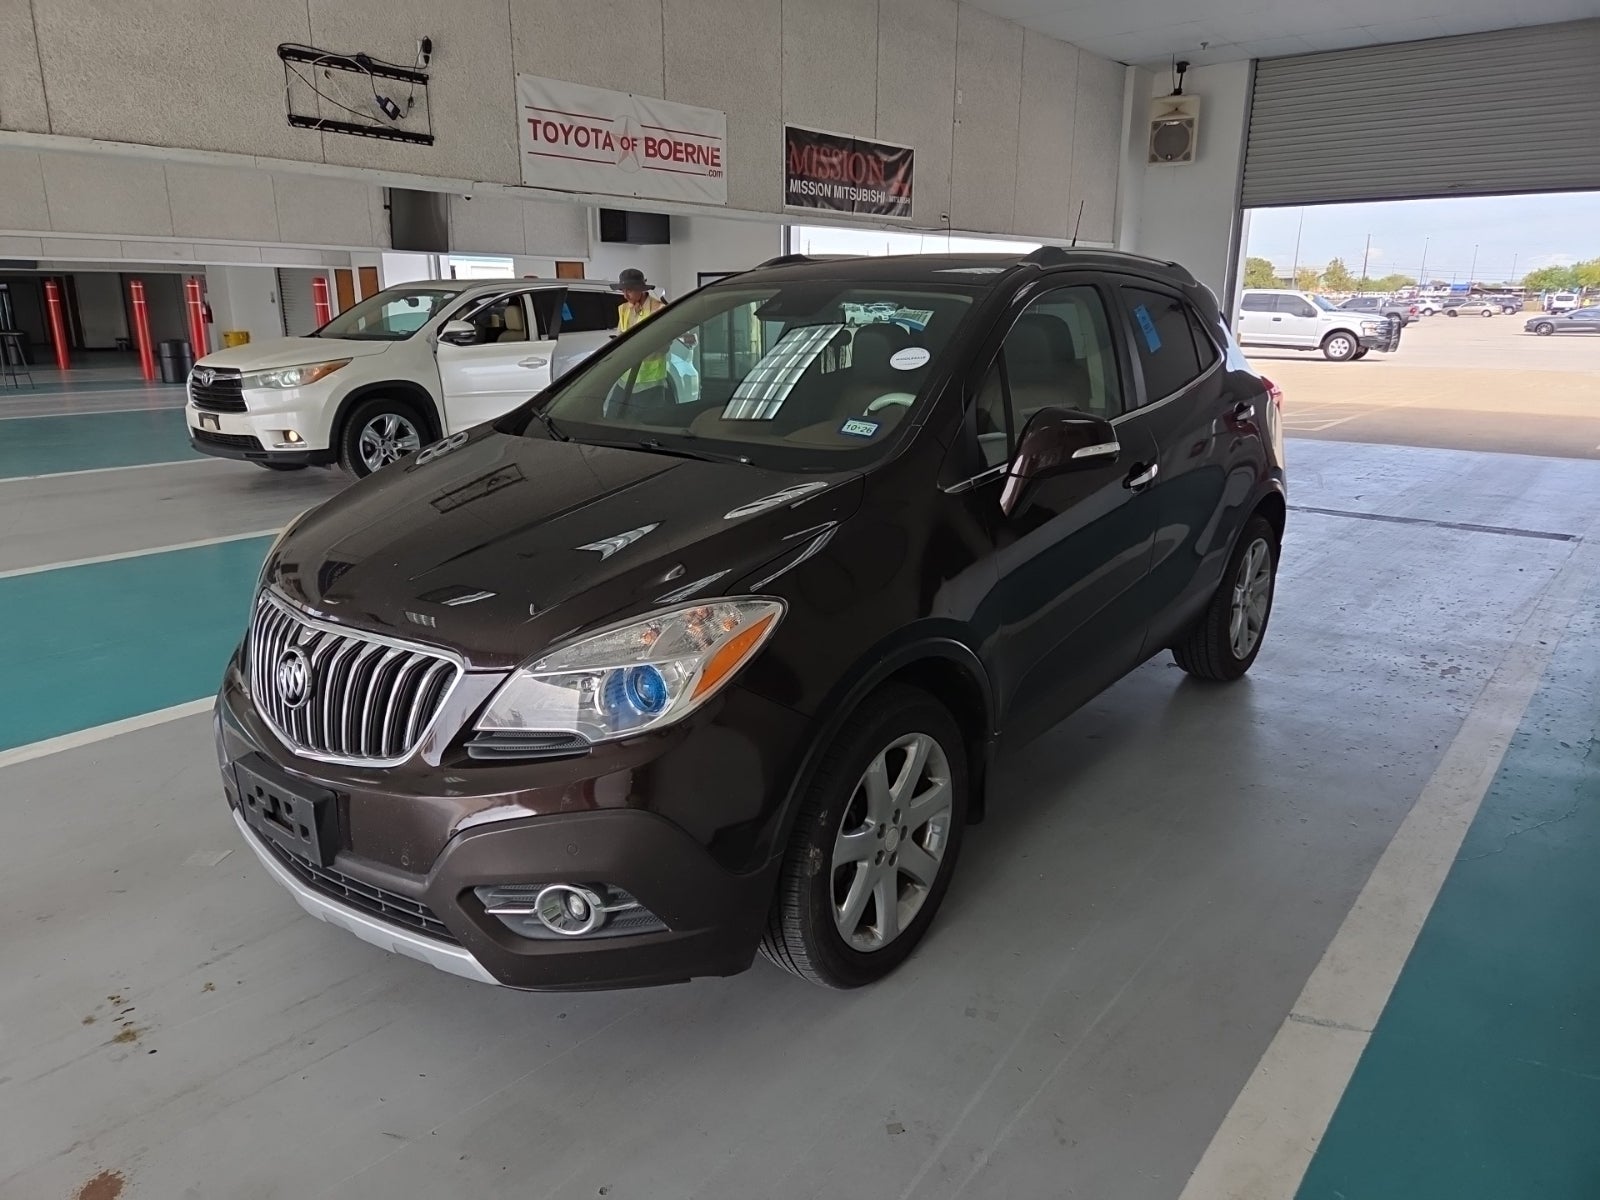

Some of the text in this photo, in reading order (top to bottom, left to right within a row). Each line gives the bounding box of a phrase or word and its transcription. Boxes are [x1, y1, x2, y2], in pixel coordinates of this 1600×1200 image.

[528, 118, 721, 167] TOYOTA OF BOERNE
[706, 169, 723, 178] .com
[789, 141, 886, 187] MISSION
[789, 178, 886, 204] MISSION MITSUBISHI
